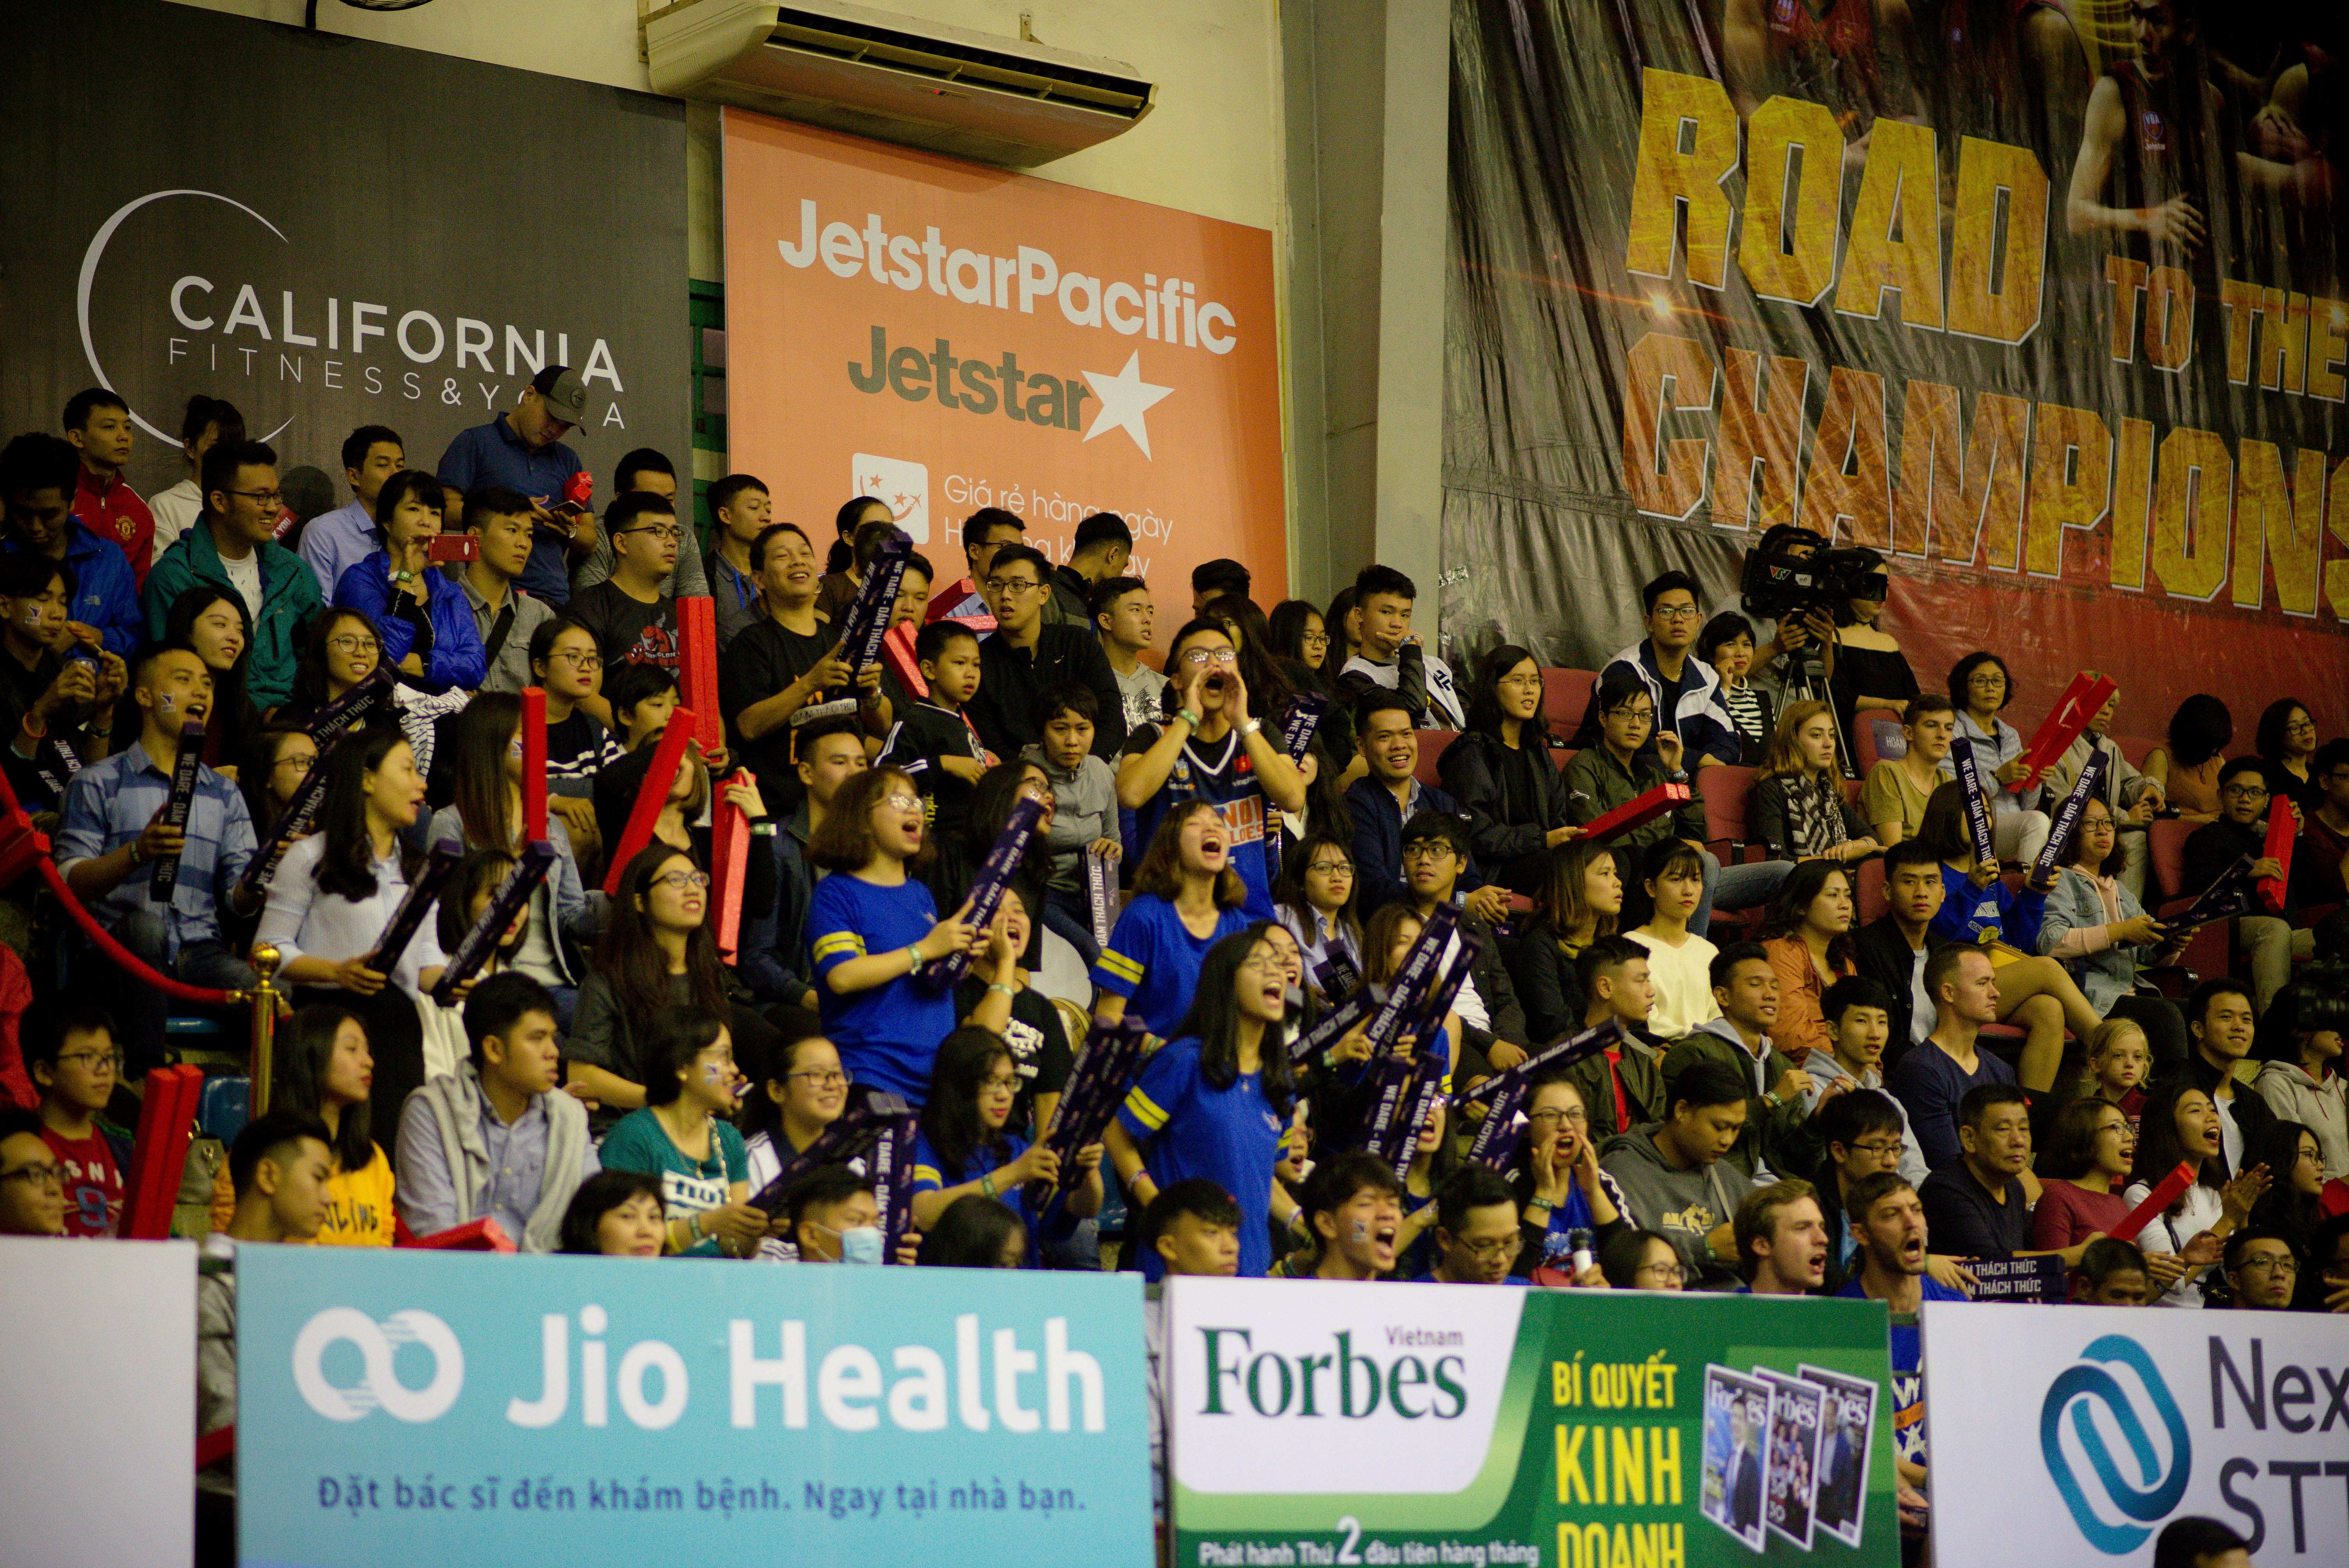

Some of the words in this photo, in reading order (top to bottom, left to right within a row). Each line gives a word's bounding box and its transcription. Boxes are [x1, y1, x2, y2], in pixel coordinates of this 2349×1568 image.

[1626, 66, 2050, 346] ROAD
[2106, 254, 2195, 372] TO
[2222, 277, 2347, 403] THE
[778, 198, 1237, 355] JetstarPacific
[170, 276, 624, 392] CALIFORNIA
[170, 337, 625, 429] FITNESS&YA
[848, 325, 1092, 431] Jetstar
[945, 475, 991, 508] Giá
[1000, 484, 1025, 514] rẻ
[893, 561, 905, 575] WE
[1770, 565, 1792, 581] VTV
[882, 576, 900, 600] DARE
[346, 695, 375, 717] THỨC
[1305, 714, 1319, 730] WE
[1294, 728, 1313, 753] DARE
[1961, 758, 1971, 773] WE
[2082, 765, 2097, 780] WE
[1964, 772, 1977, 795] DARE
[2073, 777, 2091, 798] DARE
[1971, 800, 1983, 820] DÁM
[2061, 802, 2078, 821] DÁM
[1975, 820, 1990, 846] THÁCH
[2050, 820, 2070, 846] THÁCH
[1982, 845, 1993, 861] THỨ
[2039, 844, 2058, 867] THỨC
[1421, 937, 1441, 955] WE
[1406, 951, 1430, 981] DARE
[1382, 1084, 1399, 1102] WE
[1420, 1080, 1437, 1098] WE
[1372, 1102, 1394, 1131] DARE
[1410, 1098, 1430, 1128] DARE
[75, 1185, 108, 1228] 9
[1975, 1261, 2008, 1277] THÁCH
[2010, 1258, 2037, 1274] THỨC
[1979, 1279, 2012, 1295] THÁCH
[2013, 1277, 2042, 1293] THỨC
[1386, 1326, 1463, 1347] Vietnam
[507, 1304, 688, 1429] Jio
[729, 1313, 1105, 1433] Health
[1198, 1328, 1467, 1419] Forbes
[1552, 1350, 1583, 1408] BÍ
[1590, 1349, 1677, 1409] QUYẾT
[1708, 1382, 1766, 1425] Fores
[1555, 1424, 1682, 1506] KINH
[317, 1474, 381, 1516] Đặt
[393, 1474, 457, 1512] bác
[469, 1474, 502, 1513] sĩ
[511, 1474, 577, 1512] đến
[588, 1475, 684, 1513] khám
[804, 1482, 882, 1519] Ngay
[897, 1481, 938, 1516] tại
[949, 1481, 1007, 1511] nhà
[1199, 1541, 1242, 1565] Phát
[1244, 1542, 1294, 1565] hành
[1297, 1540, 1334, 1565] Thứ
[1336, 1517, 1362, 1563] 2
[1403, 1541, 1438, 1565] tiên
[1440, 1540, 1486, 1568] hàng
[1488, 1540, 1539, 1568] tháng
[1557, 1521, 1685, 1568] DOANH
